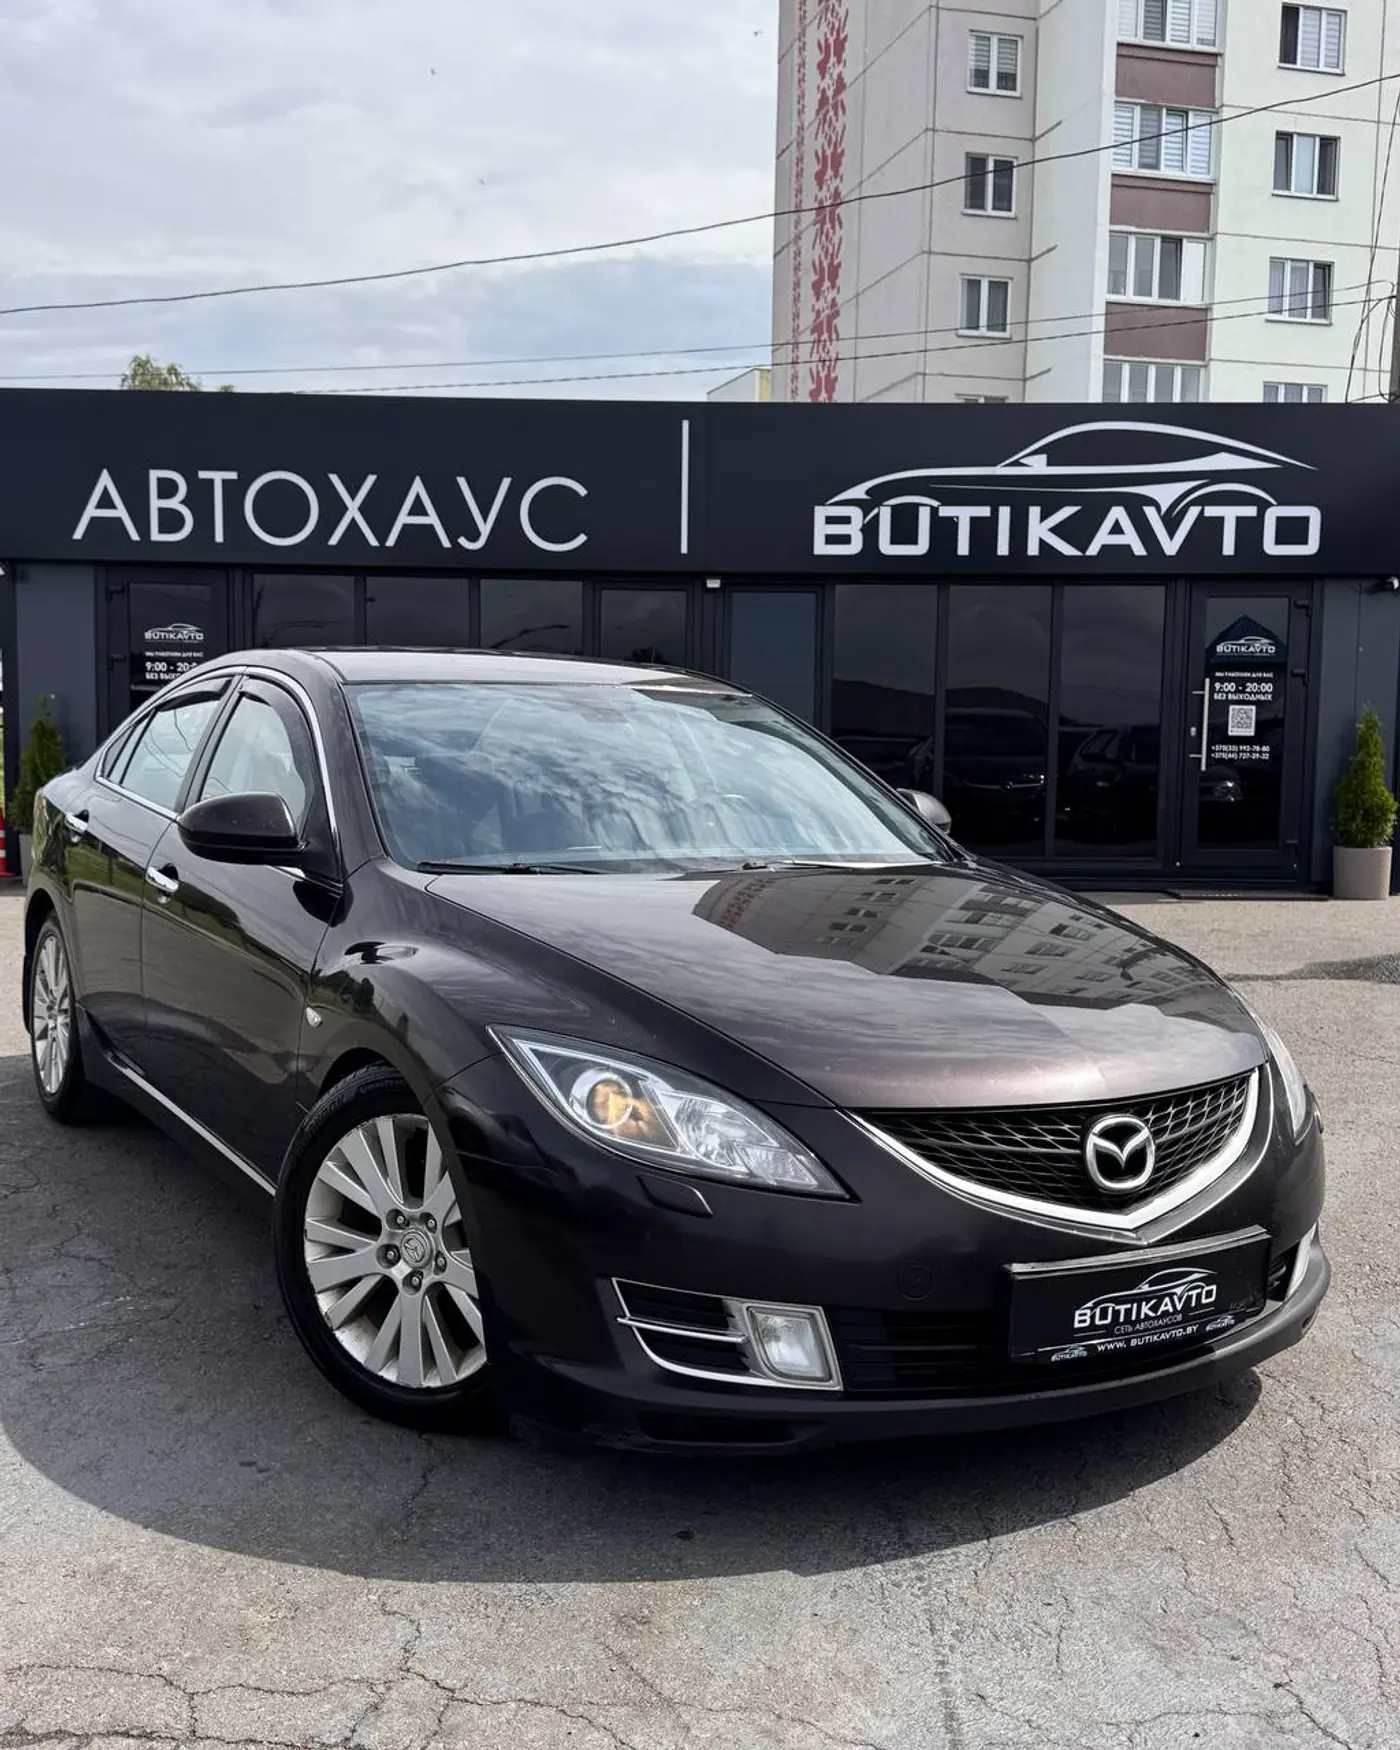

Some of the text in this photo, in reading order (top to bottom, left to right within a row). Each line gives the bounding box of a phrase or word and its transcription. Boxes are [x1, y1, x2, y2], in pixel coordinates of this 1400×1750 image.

[72, 468, 588, 552] АВТОХАУС
[813, 504, 1321, 557] BUTIKAVTO
[144, 631, 204, 640] BUTIKAVTO
[1216, 644, 1276, 654] BUTIKAVTO
[145, 661, 167, 672] 9:00
[1214, 682, 1236, 692] 9:00
[1245, 682, 1273, 692] 20:00
[1073, 1284, 1217, 1328] BUTIKAVTO
[1114, 1323, 1134, 1334] СЕТЬ
[1130, 1324, 1199, 1347] BUTIKAVTO.BY
